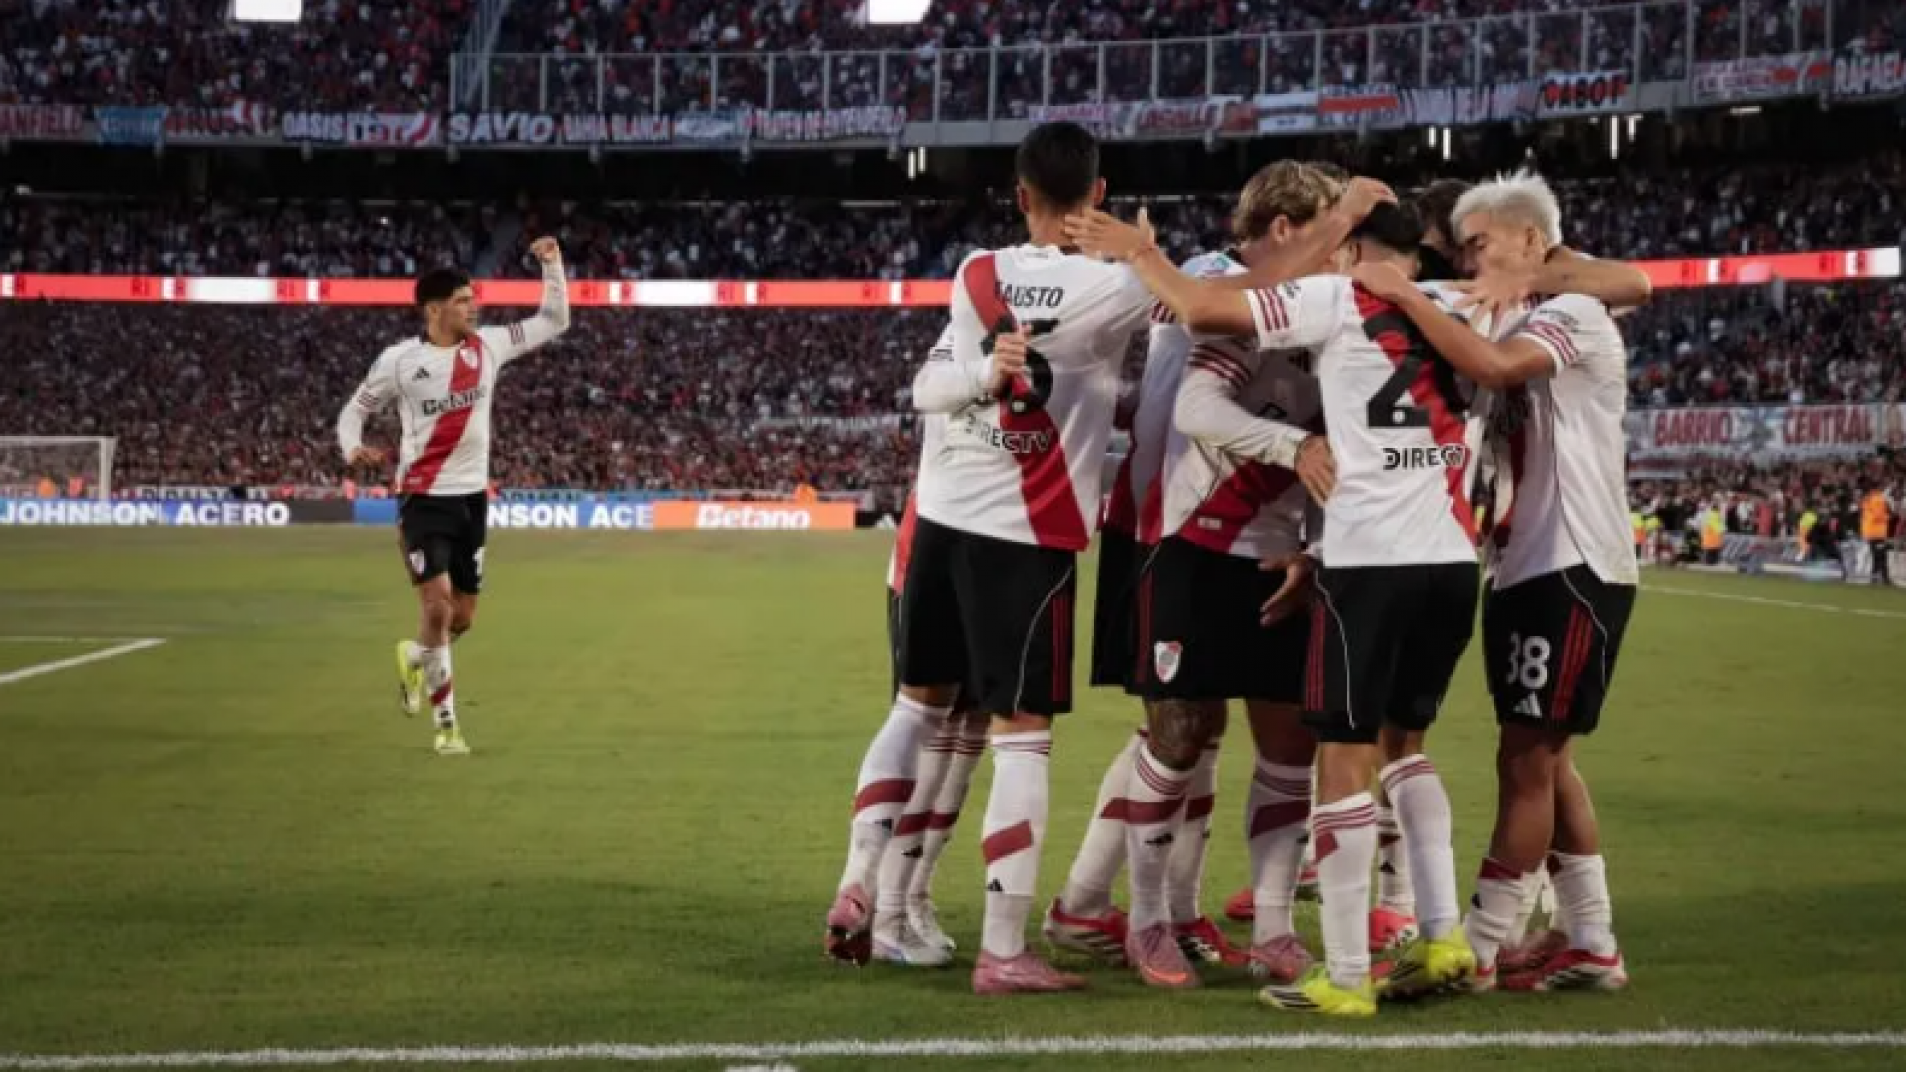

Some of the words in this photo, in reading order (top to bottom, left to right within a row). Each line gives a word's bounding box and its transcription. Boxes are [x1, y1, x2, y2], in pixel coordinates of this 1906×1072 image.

[448, 113, 554, 142] SAVIO
[1654, 410, 1732, 447] BARRIO
[1783, 404, 1873, 445] CENTRAL
[2, 502, 160, 526] JOHNSON
[175, 502, 290, 526] ACERO
[487, 503, 577, 528] NSON
[588, 503, 654, 528] ACE
[695, 503, 812, 529] Betano
[1506, 632, 1551, 690] 38
